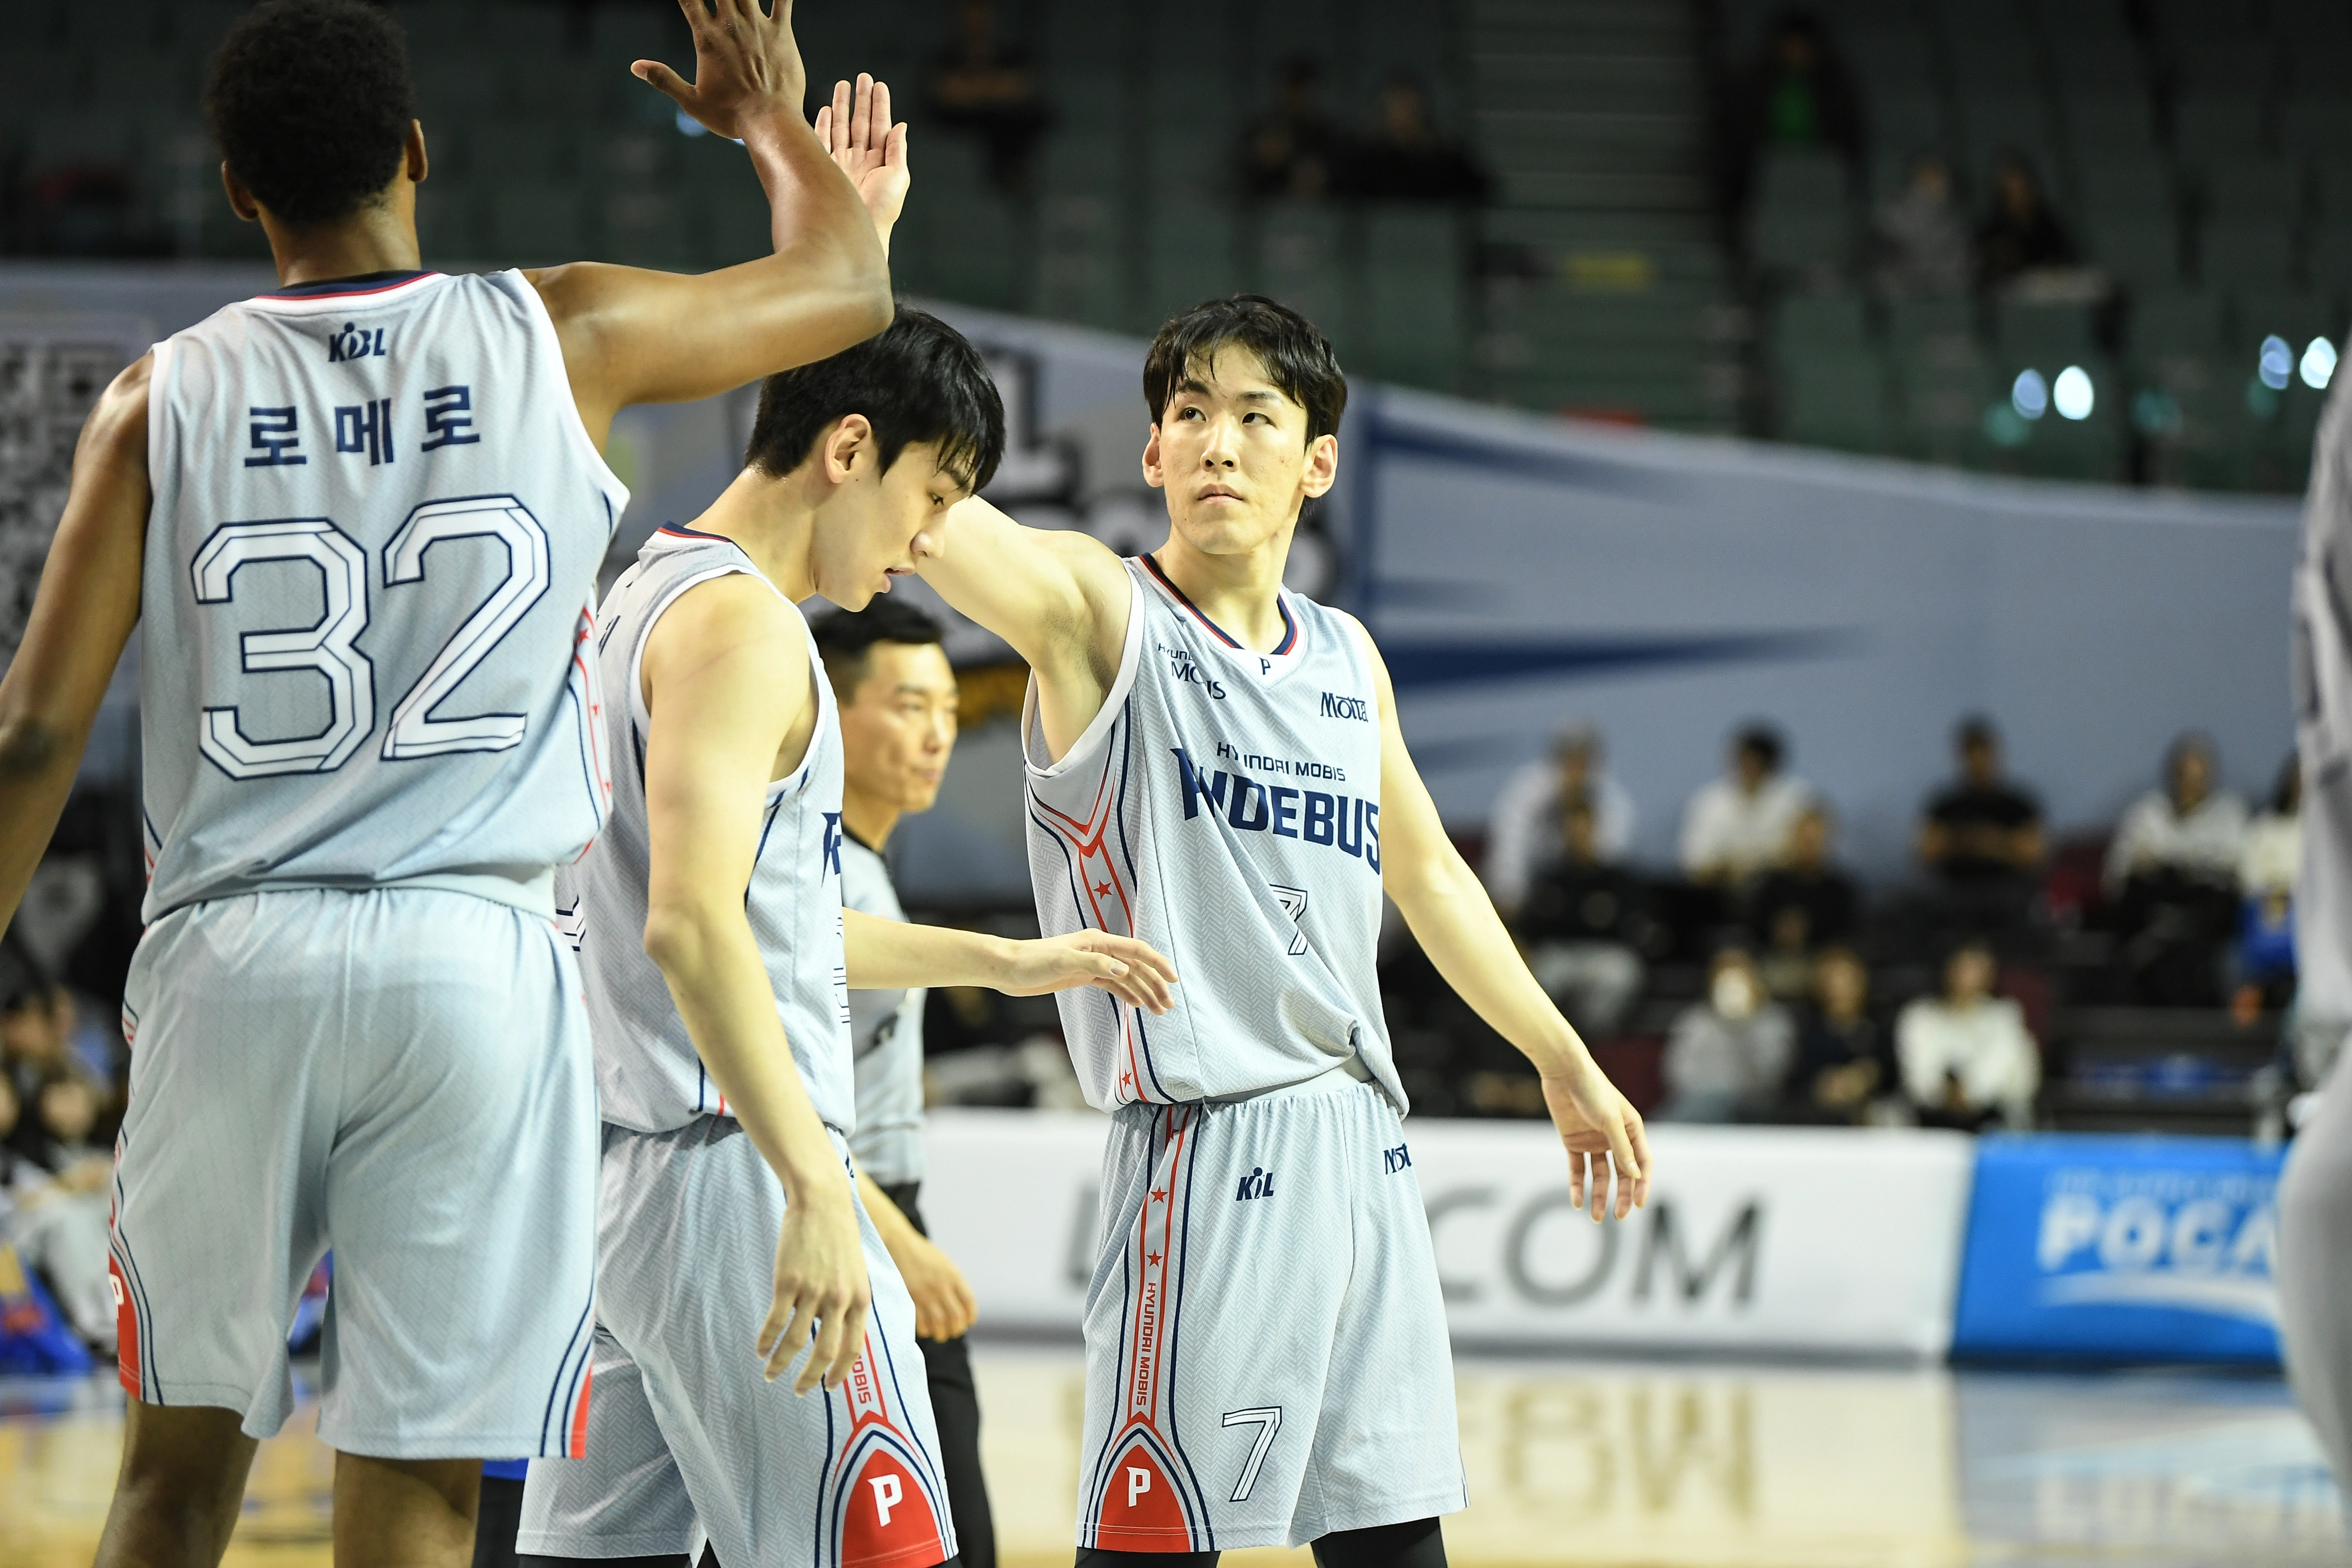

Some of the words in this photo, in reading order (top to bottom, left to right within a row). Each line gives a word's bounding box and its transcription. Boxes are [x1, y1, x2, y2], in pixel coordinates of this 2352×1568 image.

[328, 321, 386, 362] KBL
[243, 385, 481, 467] 로메로
[191, 493, 551, 781] 32
[1295, 761, 1346, 782] MOBIS
[1140, 1282, 1157, 1353] HYUNDAI
[851, 1355, 872, 1405] OBIS
[1136, 1356, 1151, 1406] MOBIS
[1221, 1406, 1282, 1502] 7
[867, 1473, 903, 1527] P
[1126, 1466, 1151, 1507] P
